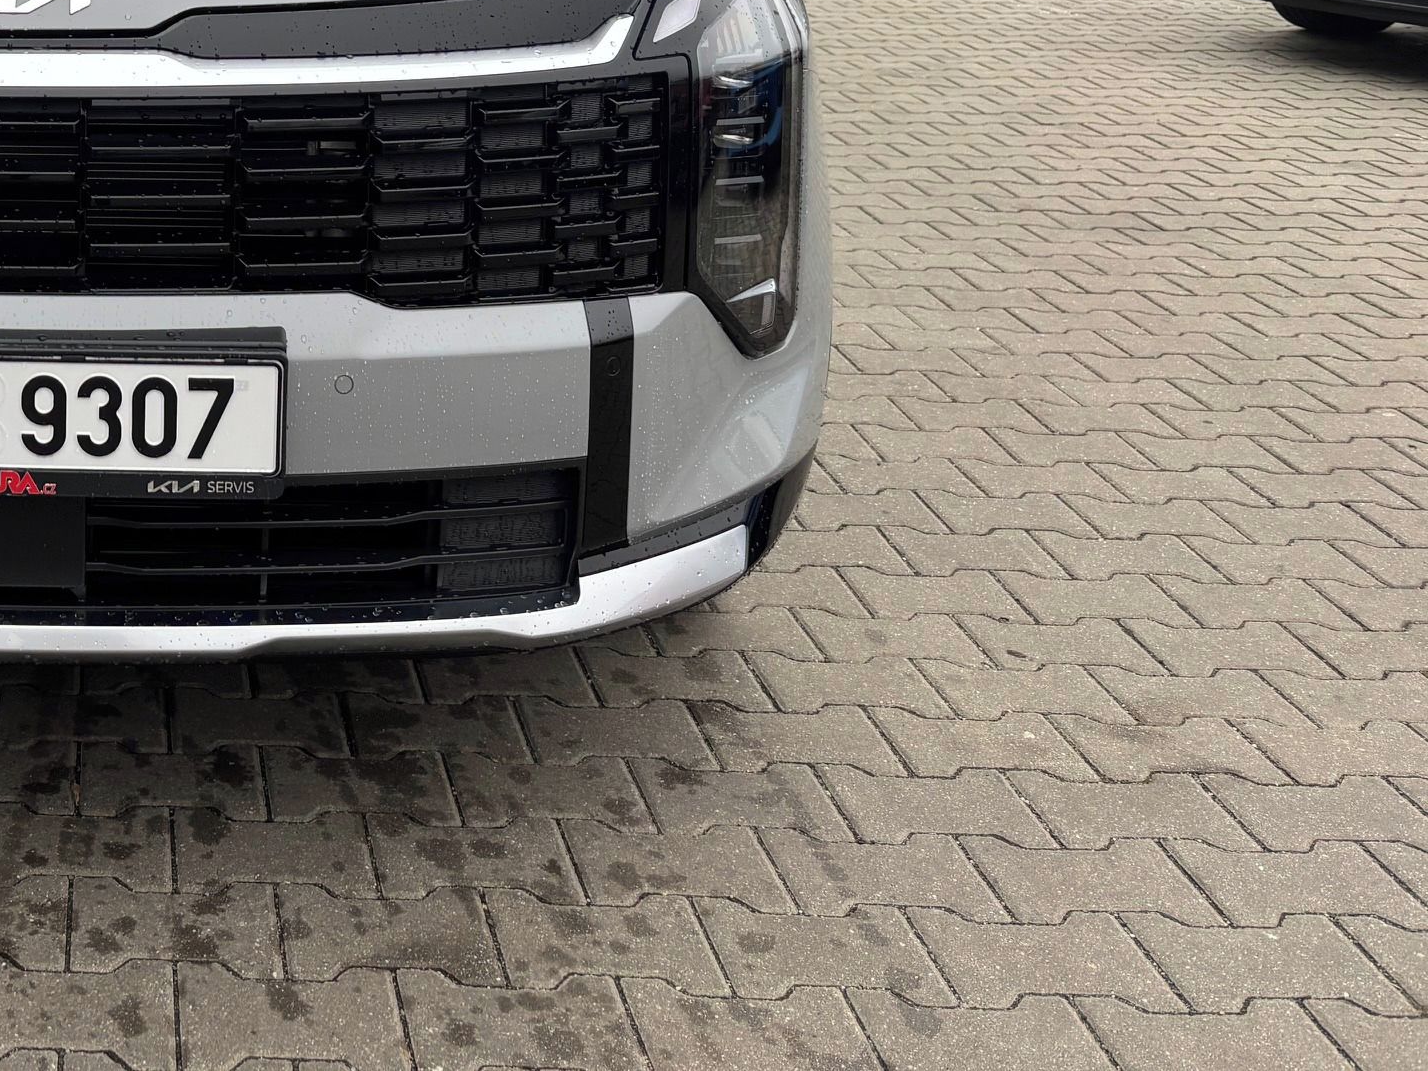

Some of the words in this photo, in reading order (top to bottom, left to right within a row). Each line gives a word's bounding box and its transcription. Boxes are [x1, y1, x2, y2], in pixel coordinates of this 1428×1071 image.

[21, 374, 235, 460] 9307
[147, 480, 200, 494] KIA
[207, 481, 255, 494] SERVIS
